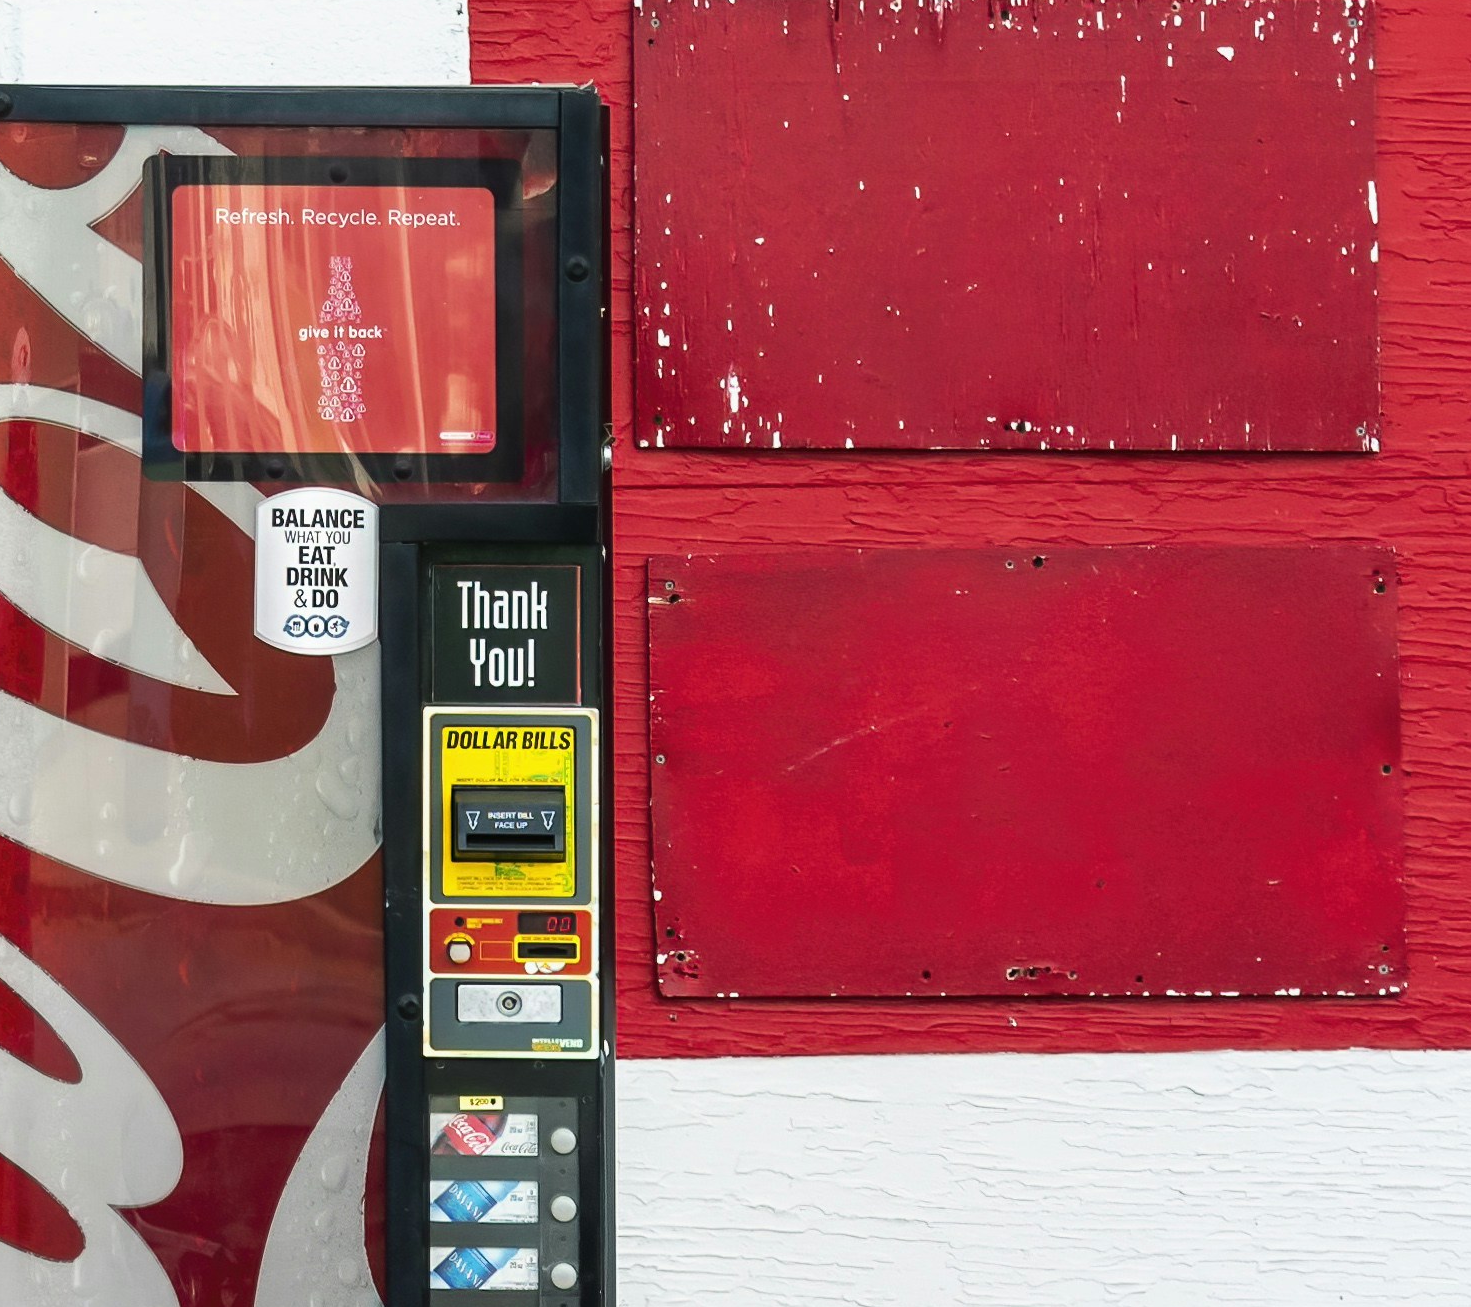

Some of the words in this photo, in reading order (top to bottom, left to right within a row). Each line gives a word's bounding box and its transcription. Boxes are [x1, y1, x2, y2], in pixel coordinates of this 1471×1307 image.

[215, 207, 295, 226] Refresh.
[301, 208, 382, 231] Recycle.
[387, 209, 461, 231] Repeat.
[298, 327, 330, 340] give
[333, 325, 345, 339] it
[348, 324, 383, 339] back
[271, 508, 365, 529] BALANCE
[284, 530, 320, 544] WHAT
[325, 531, 351, 545] YOU
[298, 546, 337, 567] EAT,
[286, 567, 349, 587] DRINK
[293, 589, 308, 609] &
[311, 589, 339, 609] DO
[457, 581, 548, 630] Thank
[469, 638, 535, 688] You!
[446, 730, 518, 750] DOLLAR
[521, 731, 571, 750] BILLS
[487, 811, 517, 820] INSERT
[517, 811, 534, 820] BILL
[494, 821, 515, 829] FACE
